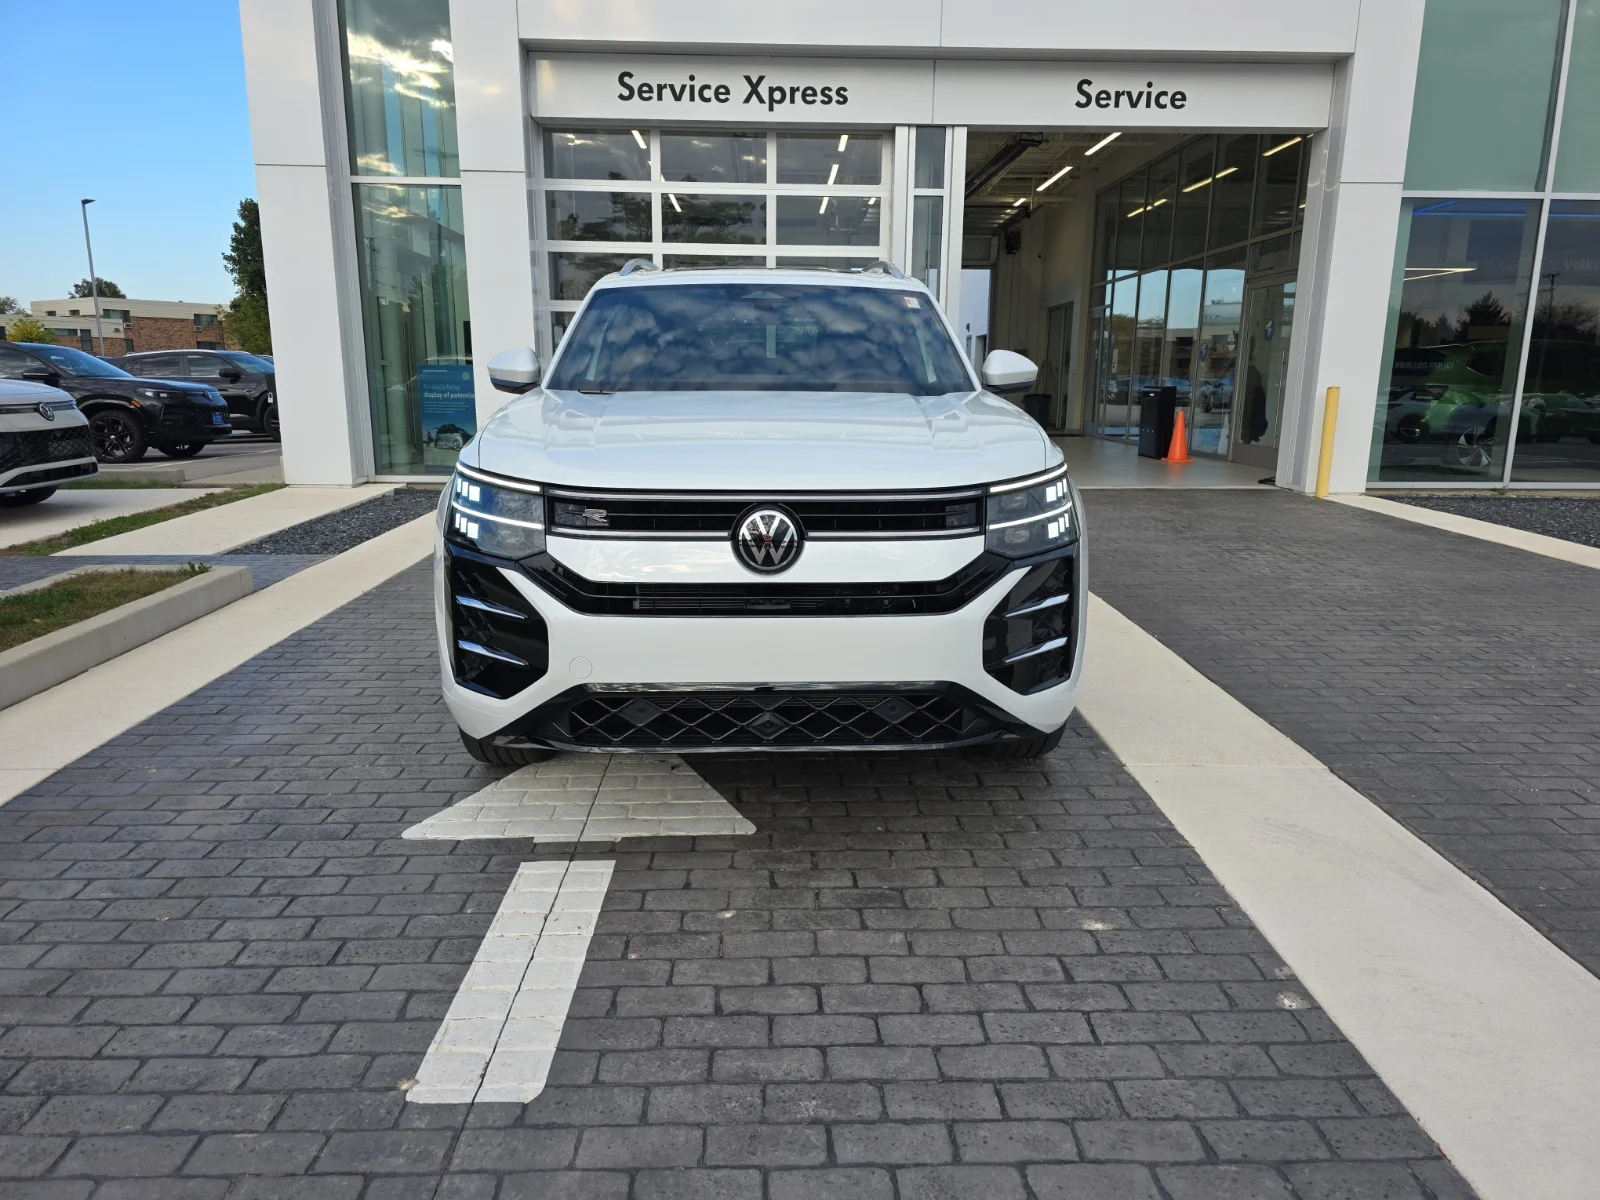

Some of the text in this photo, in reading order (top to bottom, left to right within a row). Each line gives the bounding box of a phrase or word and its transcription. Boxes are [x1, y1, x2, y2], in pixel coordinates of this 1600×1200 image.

[617, 70, 849, 112] Service Xpress
[1074, 78, 1187, 110] Service
[423, 391, 443, 400] display
[738, 509, 798, 571] VW
